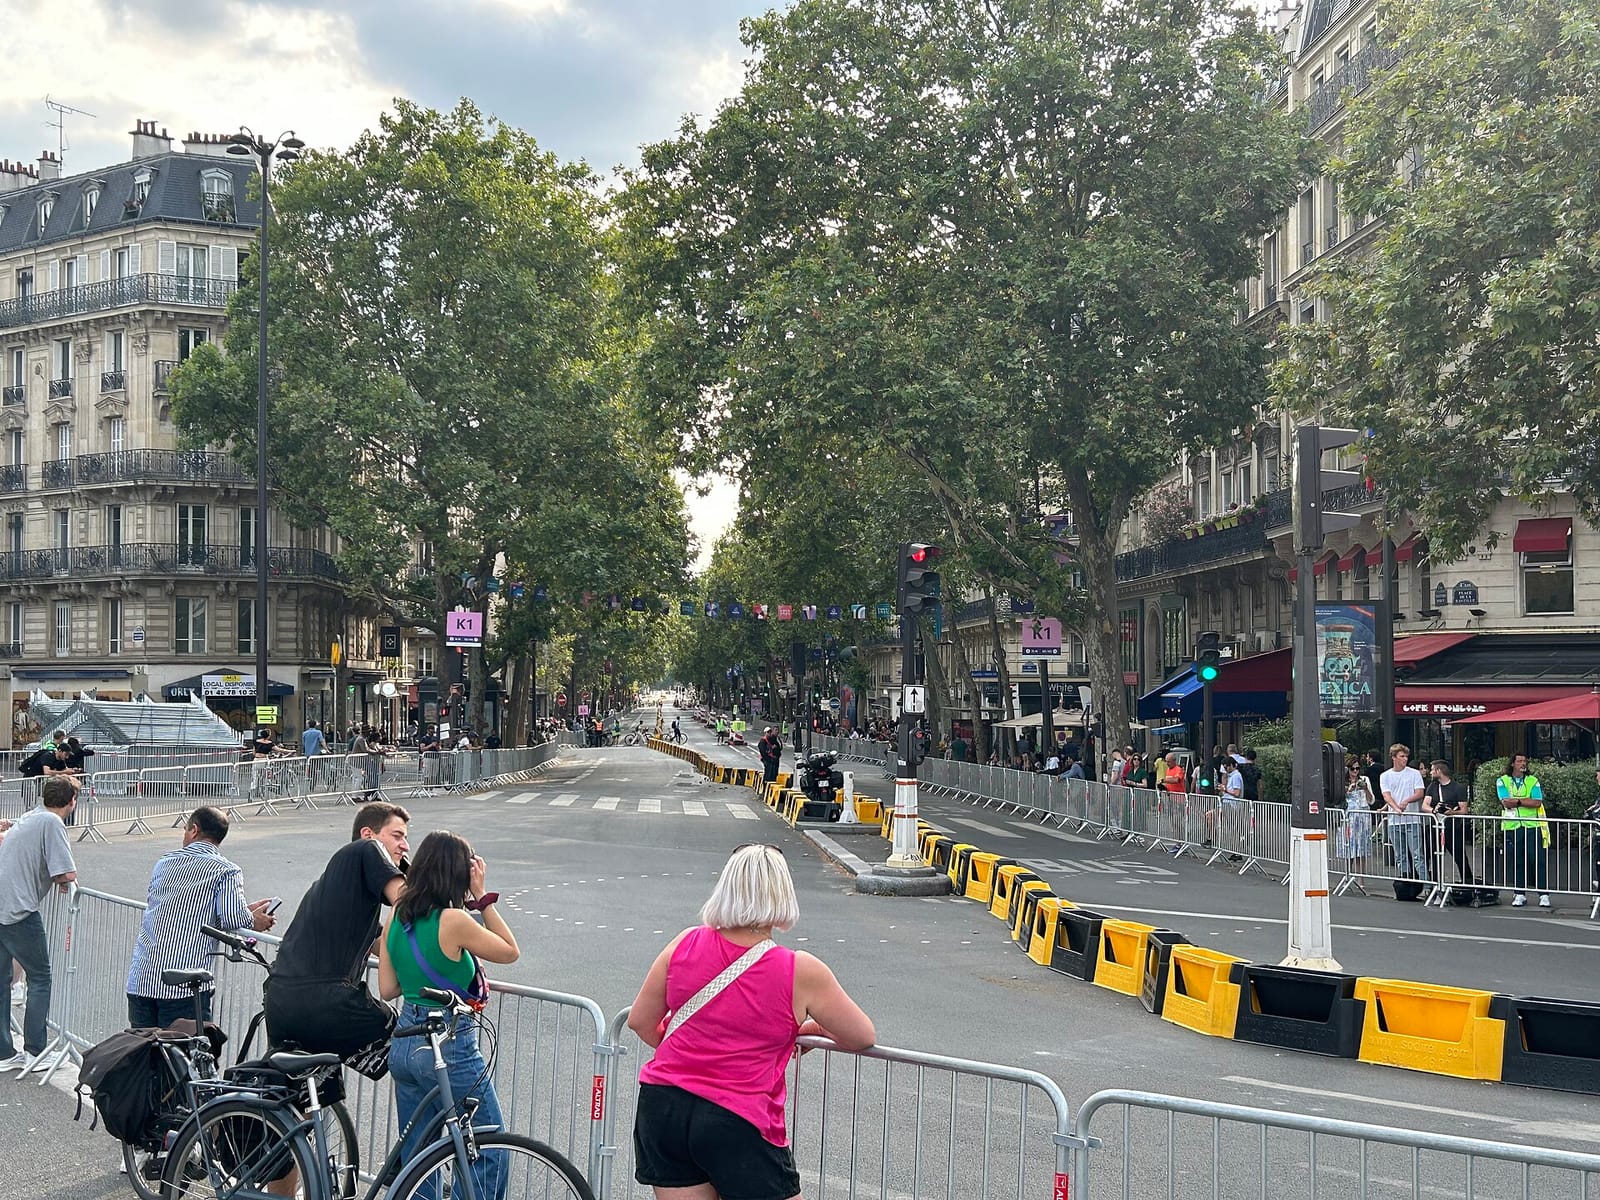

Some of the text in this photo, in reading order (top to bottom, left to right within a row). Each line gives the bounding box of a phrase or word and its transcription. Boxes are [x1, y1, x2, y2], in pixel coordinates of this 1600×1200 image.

[457, 618, 473, 630] K1
[1033, 626, 1051, 640] K1
[1320, 681, 1371, 695] EXICA
[1012, 858, 1180, 876] BUS
[594, 1088, 602, 1119] ALTRAD
